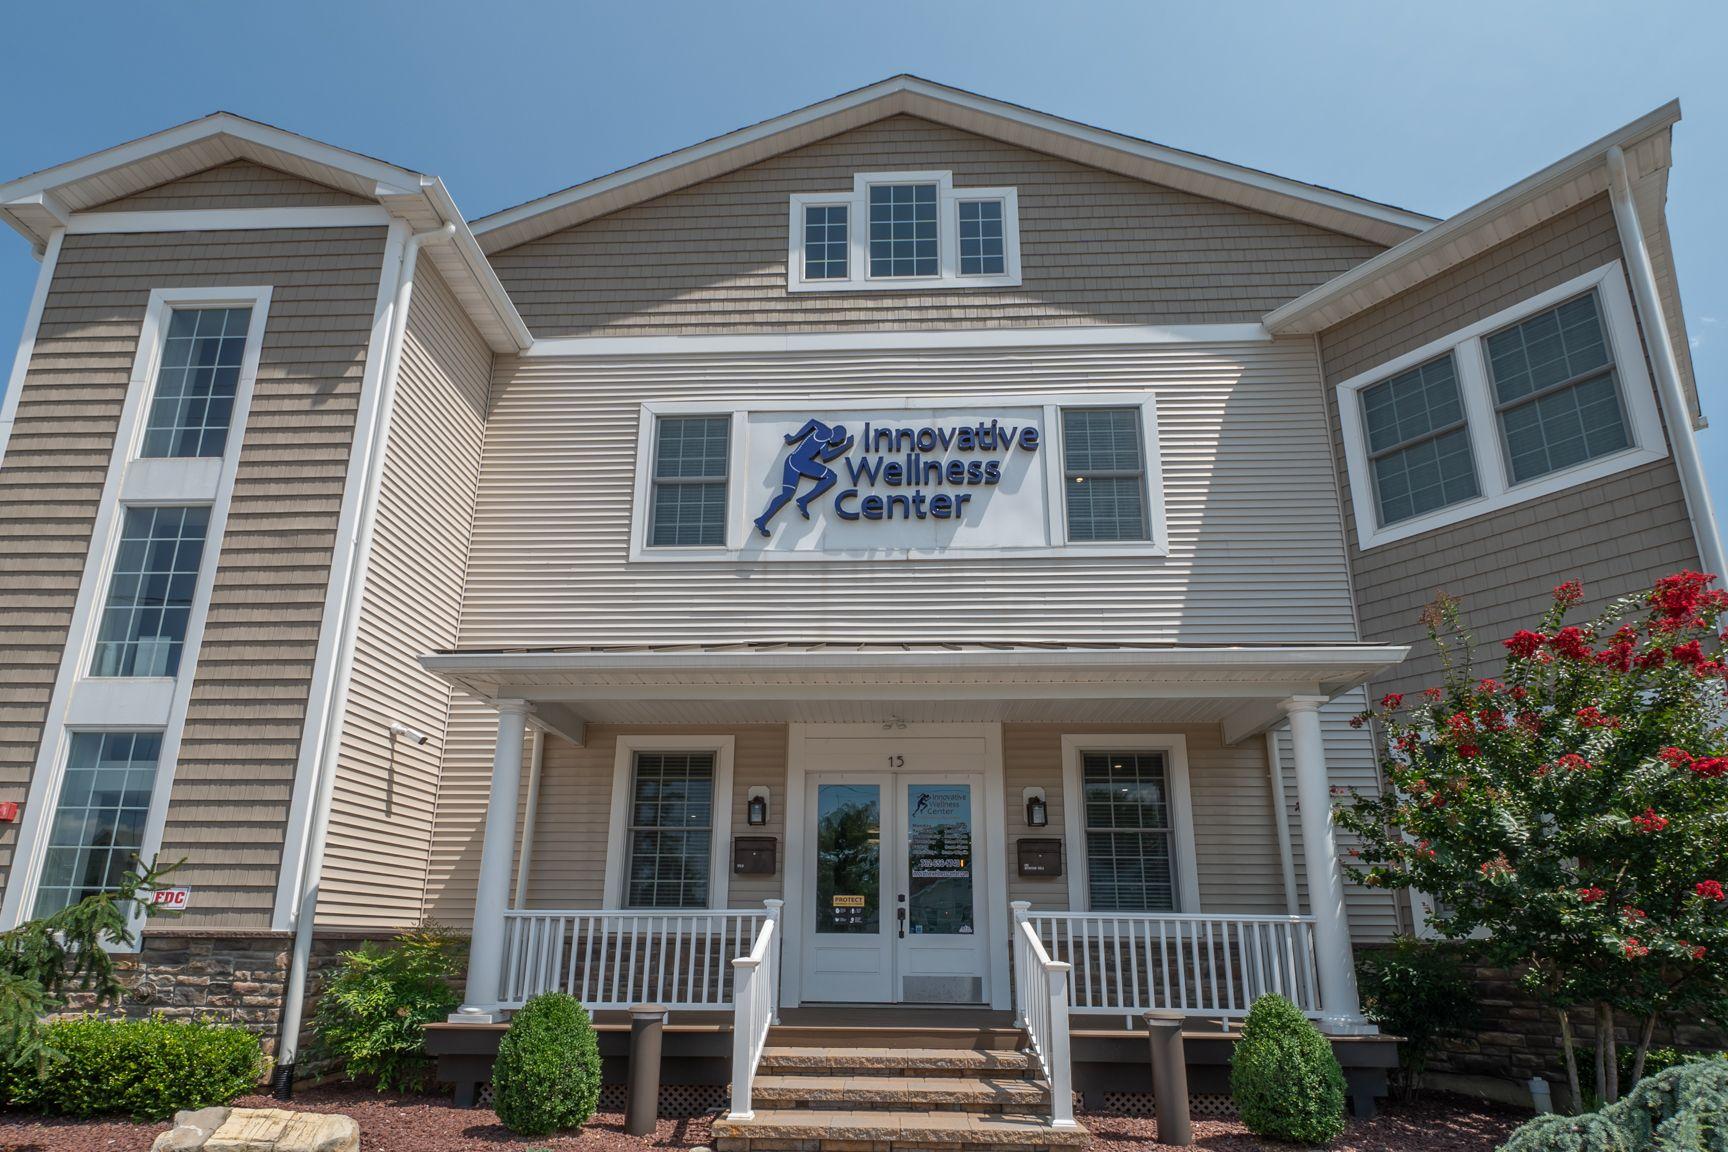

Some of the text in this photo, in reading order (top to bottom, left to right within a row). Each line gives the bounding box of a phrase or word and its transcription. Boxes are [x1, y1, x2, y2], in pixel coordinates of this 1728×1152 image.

[864, 419, 1039, 453] Innovative
[845, 453, 1001, 487] Wellness
[834, 489, 972, 520] Center
[888, 755, 904, 768] 15
[932, 793, 966, 801] Innovative
[154, 891, 185, 905] FDC
